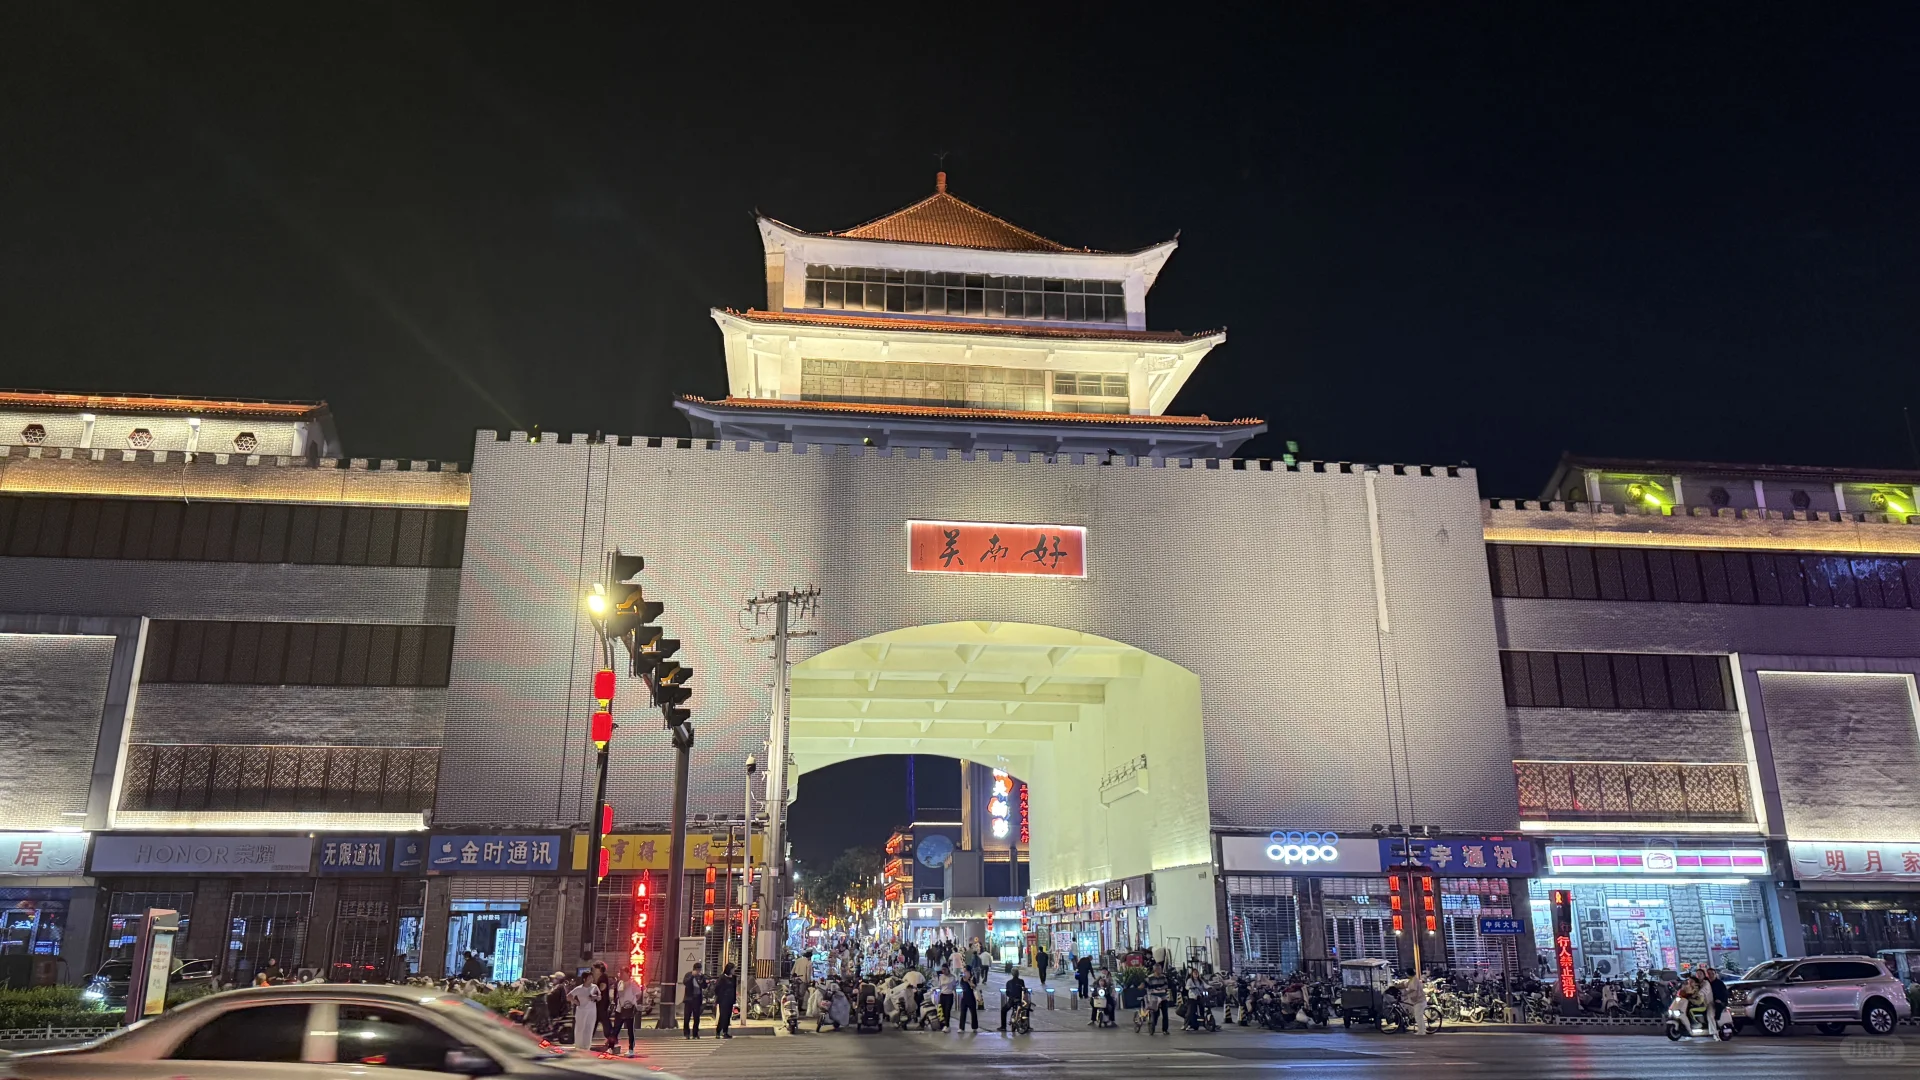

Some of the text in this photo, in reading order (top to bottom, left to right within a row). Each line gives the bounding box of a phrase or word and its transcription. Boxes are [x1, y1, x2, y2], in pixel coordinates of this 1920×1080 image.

[14, 840, 43, 867] 居
[134, 844, 230, 864] HONOR
[232, 844, 276, 864] 荣耀
[323, 842, 381, 867] 无限通讯
[460, 840, 552, 865] 金时通讯
[1266, 844, 1338, 865] oppo
[638, 913, 647, 927] 2
[1556, 935, 1577, 998] 行人禁止通行
